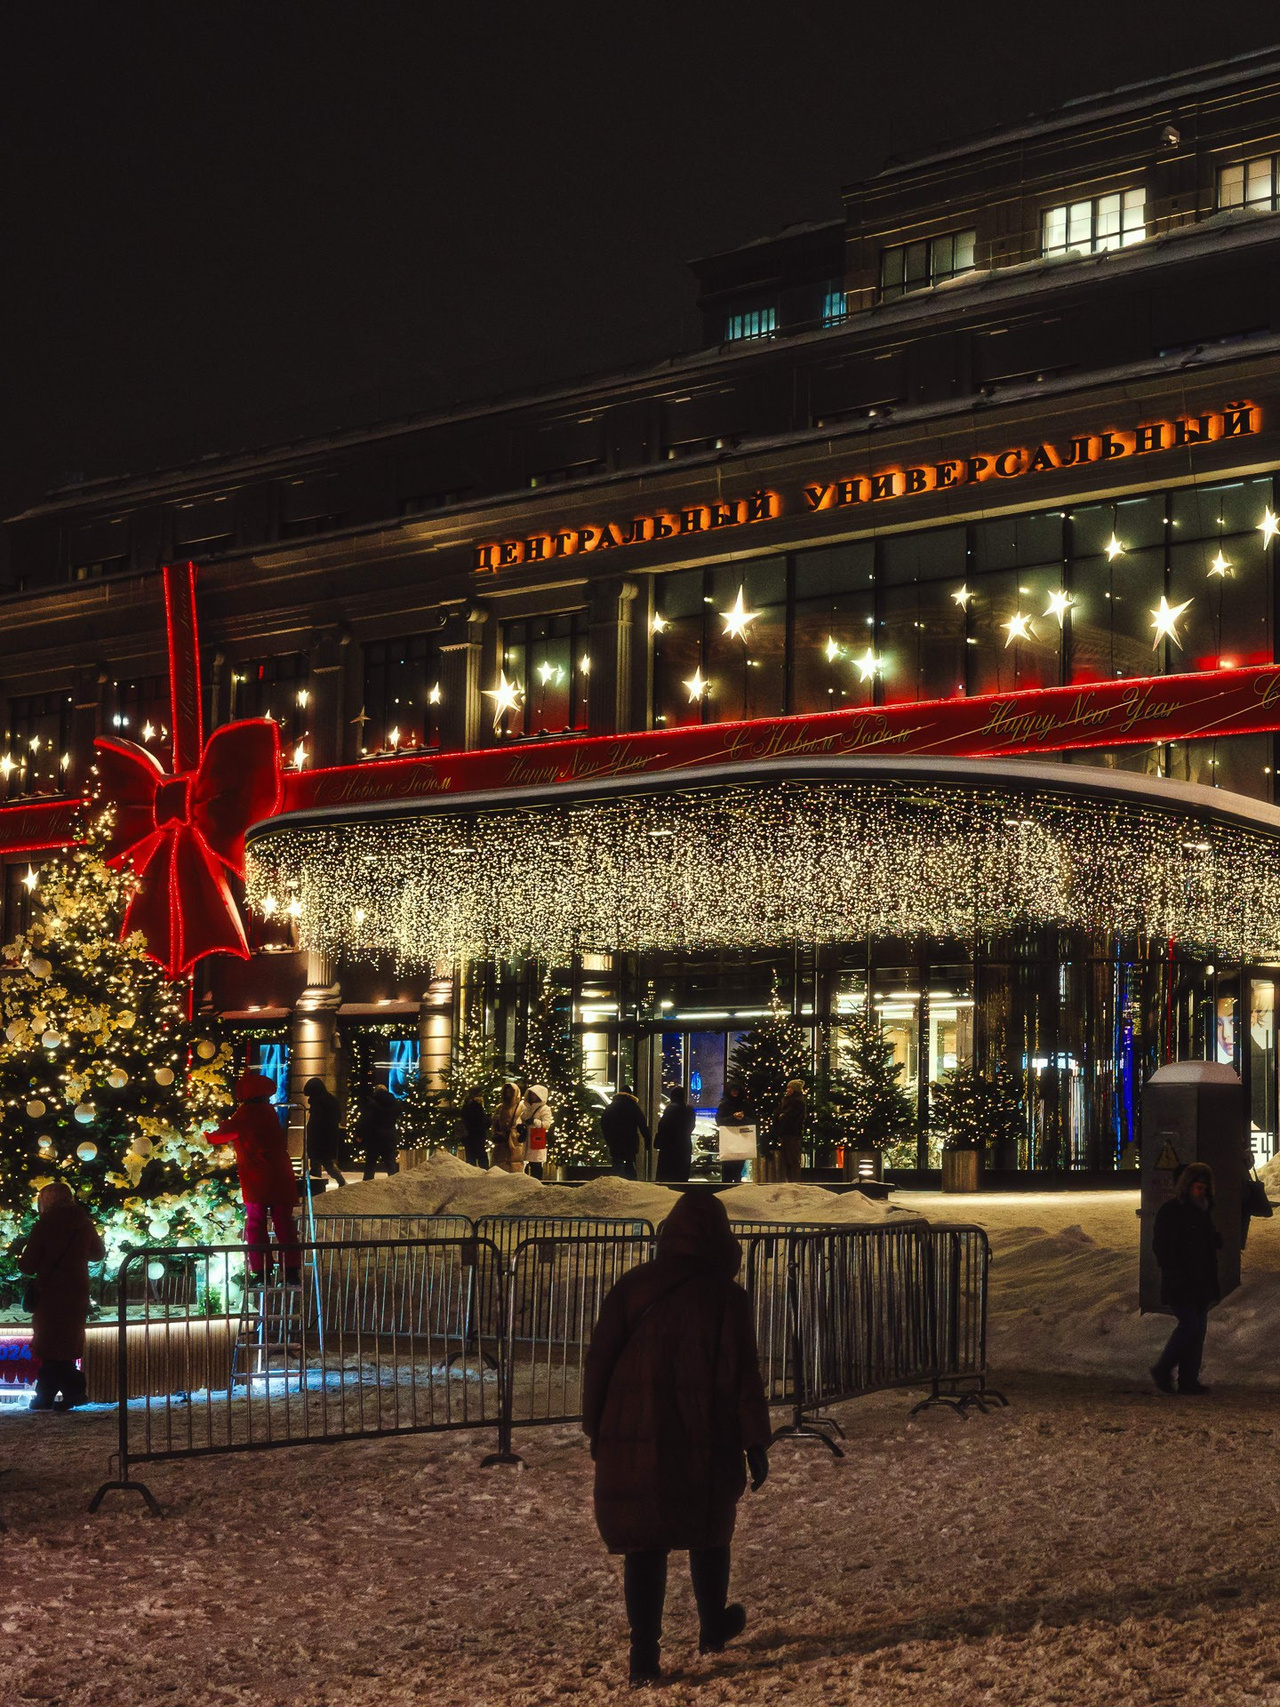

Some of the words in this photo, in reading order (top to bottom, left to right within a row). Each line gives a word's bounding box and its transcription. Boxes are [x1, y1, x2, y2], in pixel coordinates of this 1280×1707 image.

[472, 489, 775, 573] ЦЕНТРАЛЬНЫЙ
[804, 401, 1254, 513] УНИВЕРСАЛЬНЫЙ
[751, 722, 836, 758] Новым
[839, 712, 911, 749] Годом
[981, 698, 1056, 743] Happy
[1056, 690, 1111, 728] New
[1119, 684, 1181, 734] Year
[504, 754, 560, 785] Happy
[559, 747, 600, 778] New
[608, 740, 652, 778] Year
